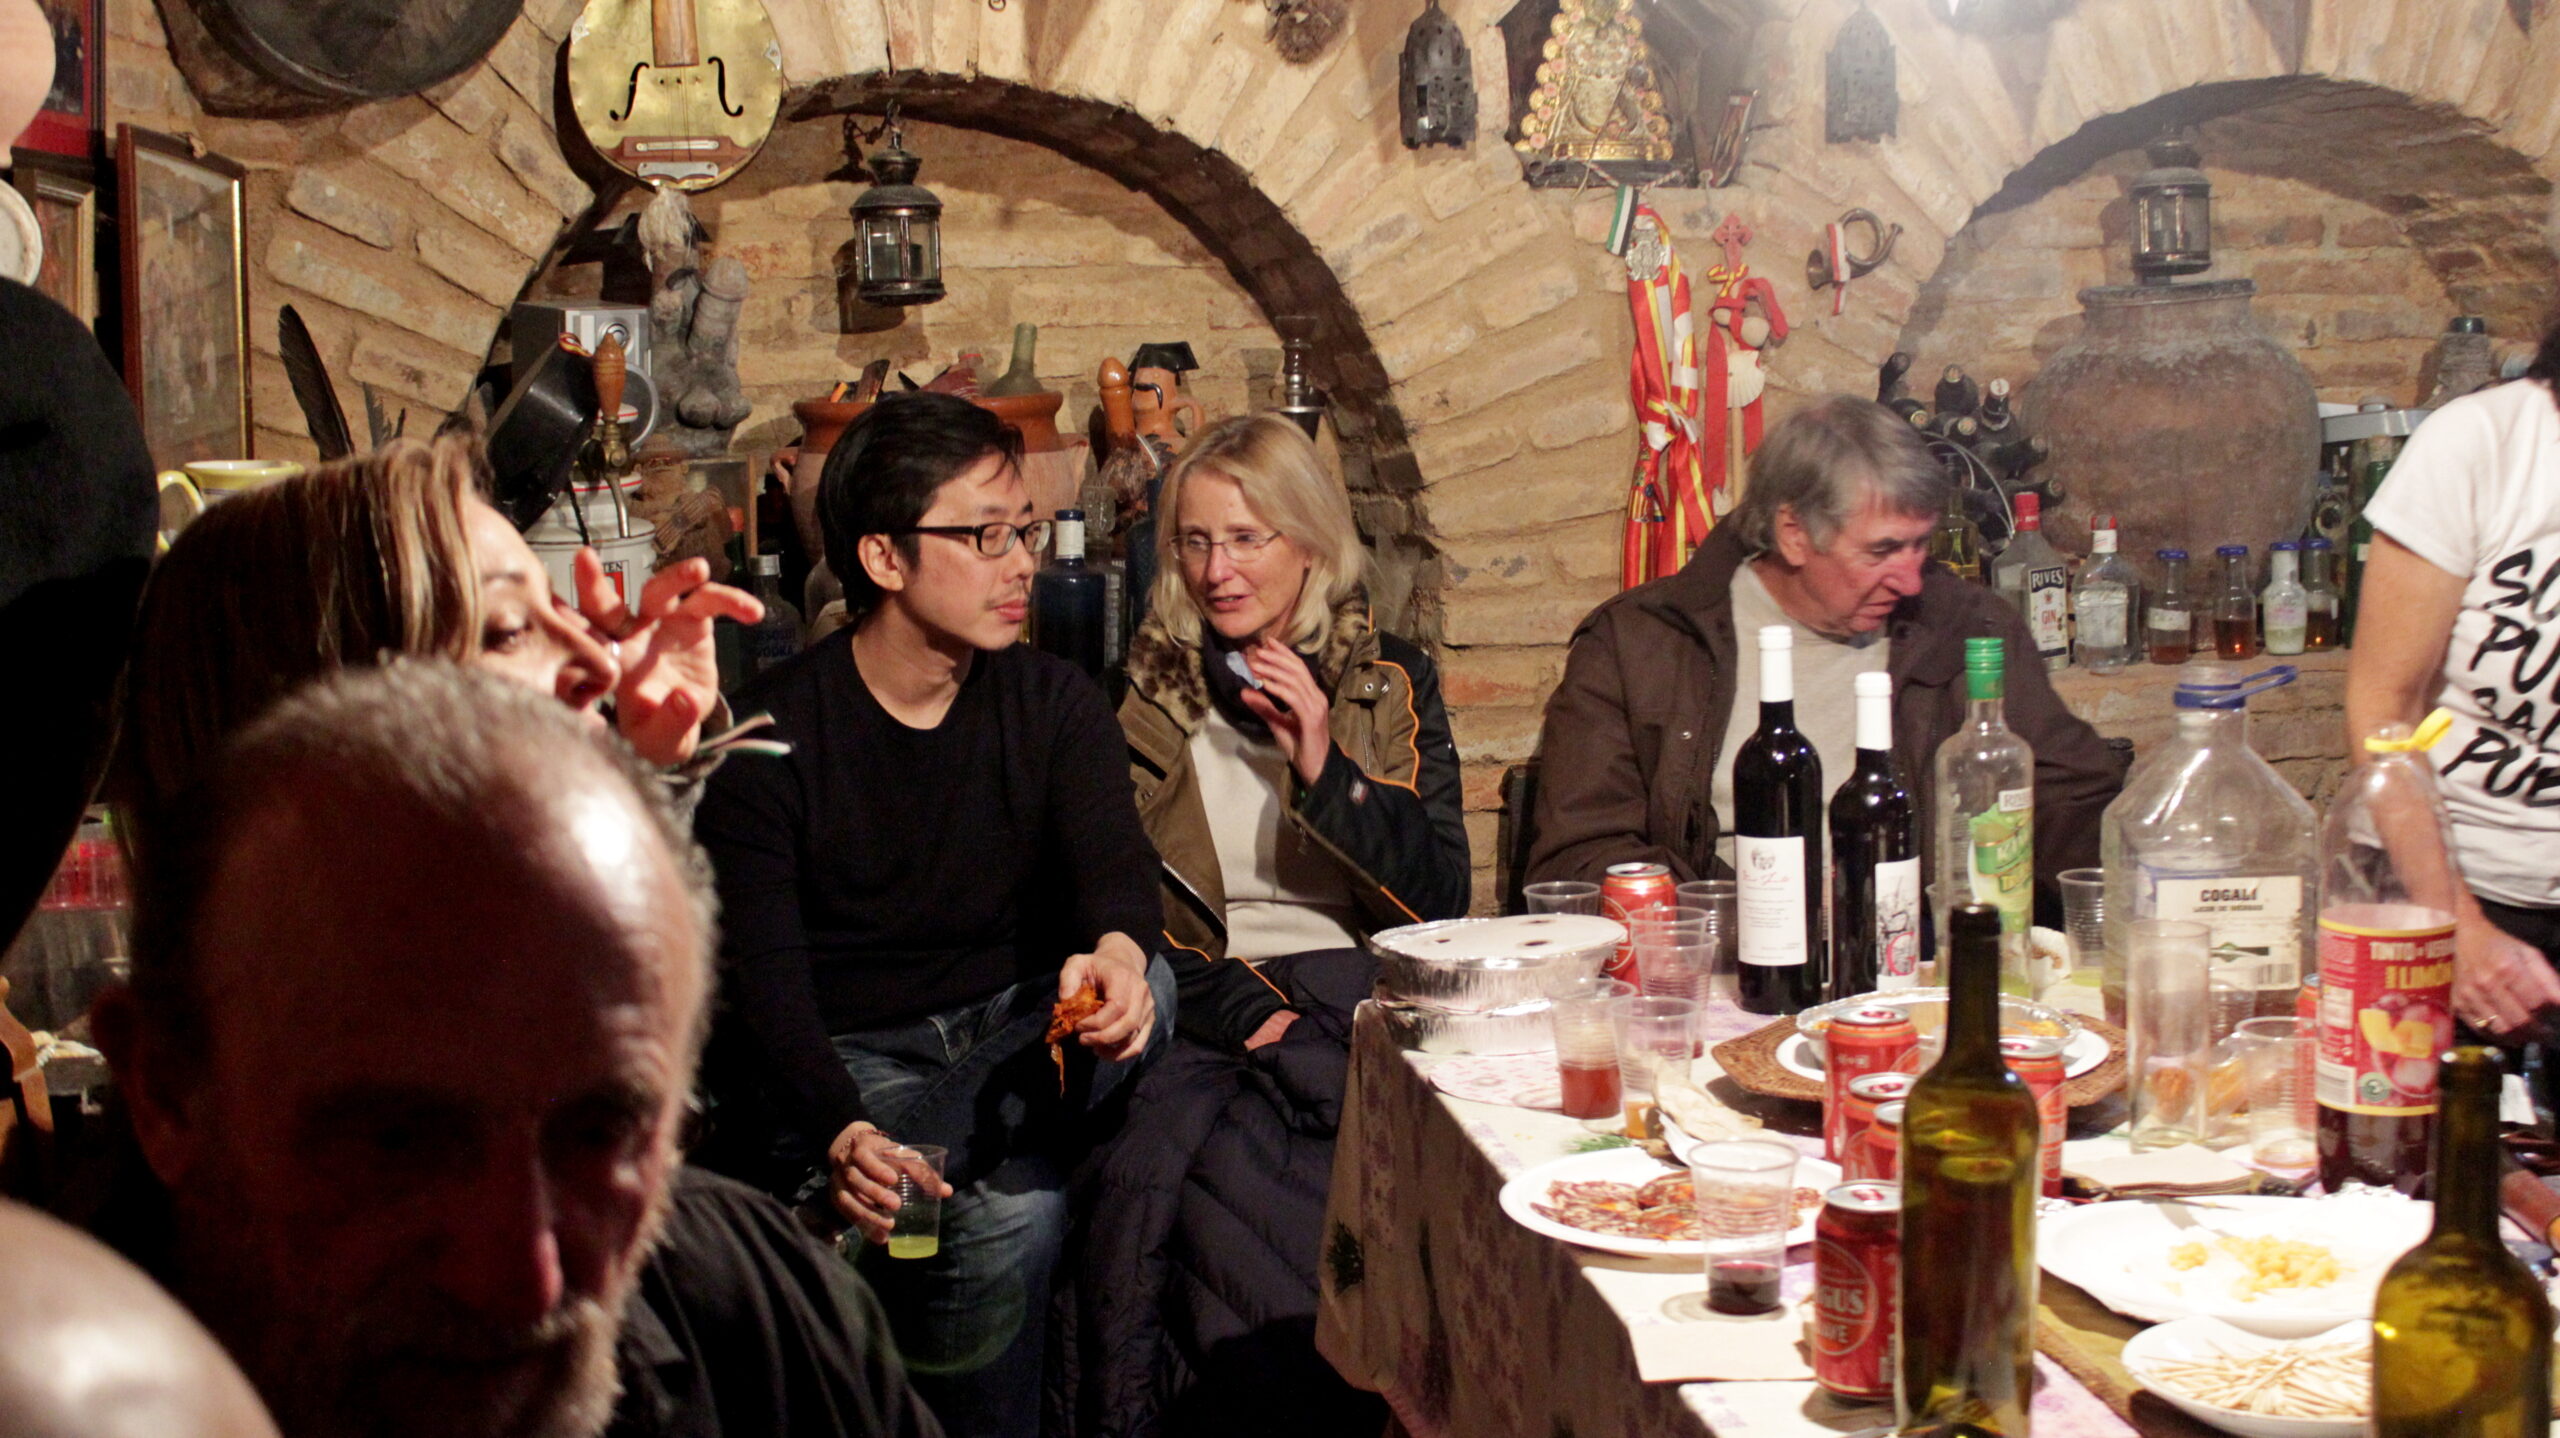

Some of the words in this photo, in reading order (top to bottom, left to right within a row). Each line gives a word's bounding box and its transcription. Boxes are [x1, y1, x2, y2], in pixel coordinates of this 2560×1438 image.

[2032, 569, 2063, 588] RIVES
[2042, 608, 2057, 624] GIN
[2469, 615, 2560, 704] PU
[1818, 1284, 1865, 1315] GUS
